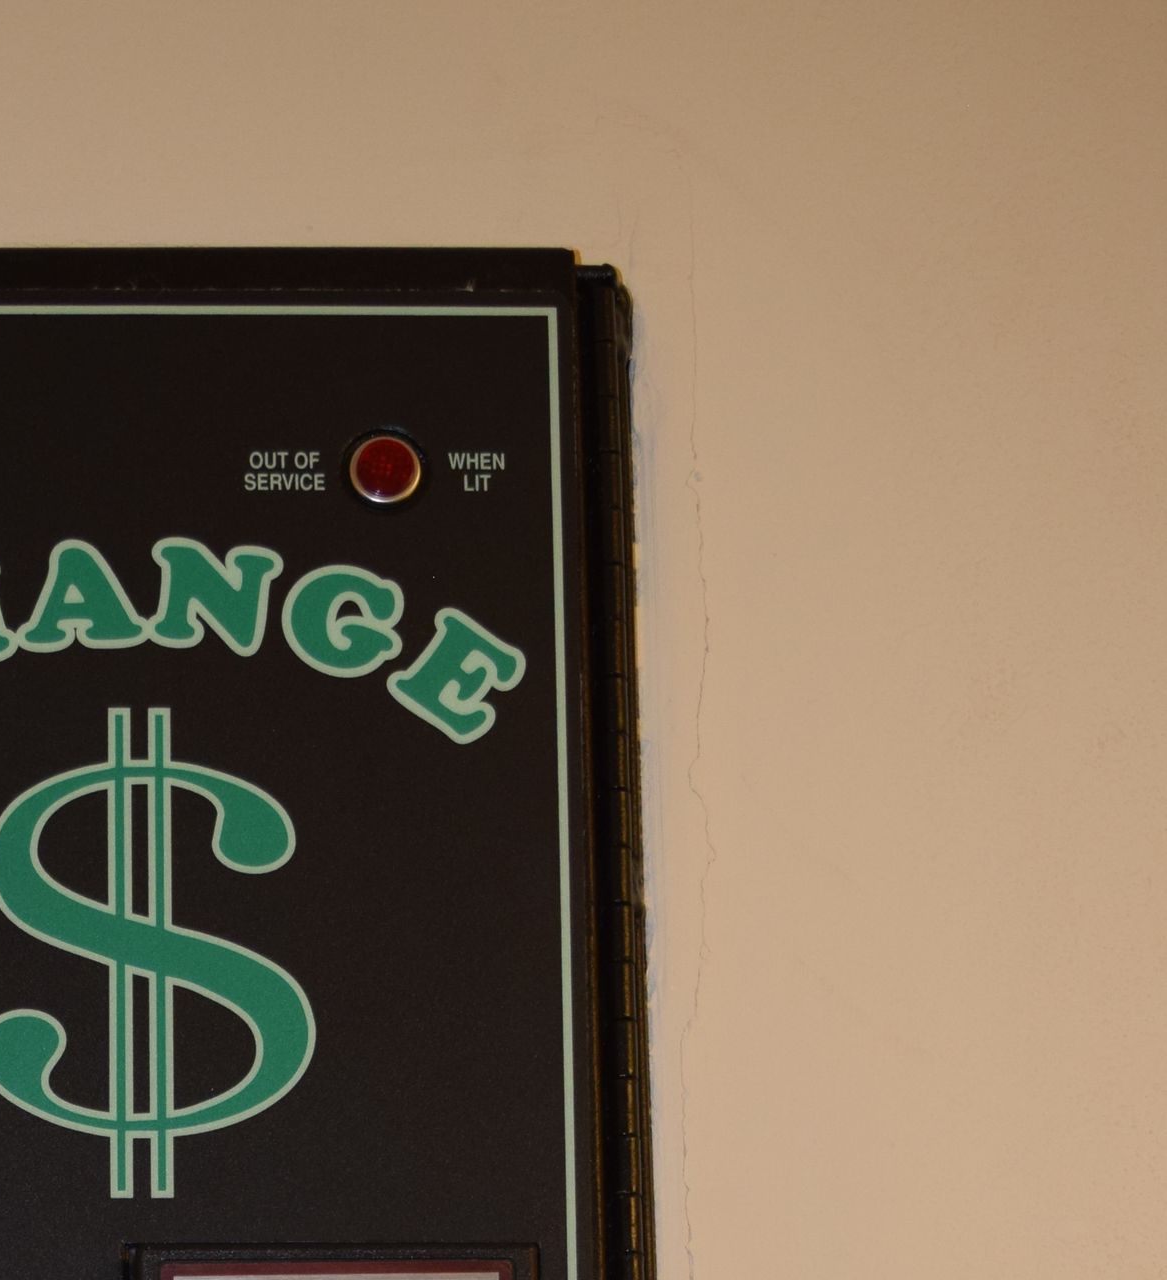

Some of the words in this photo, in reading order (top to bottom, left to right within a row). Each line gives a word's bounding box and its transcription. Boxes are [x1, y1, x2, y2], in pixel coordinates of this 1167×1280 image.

[249, 451, 289, 470] OUT
[294, 451, 320, 469] OF
[448, 452, 506, 471] WHEN
[244, 473, 326, 492] SERVICE
[463, 475, 491, 492] LIT
